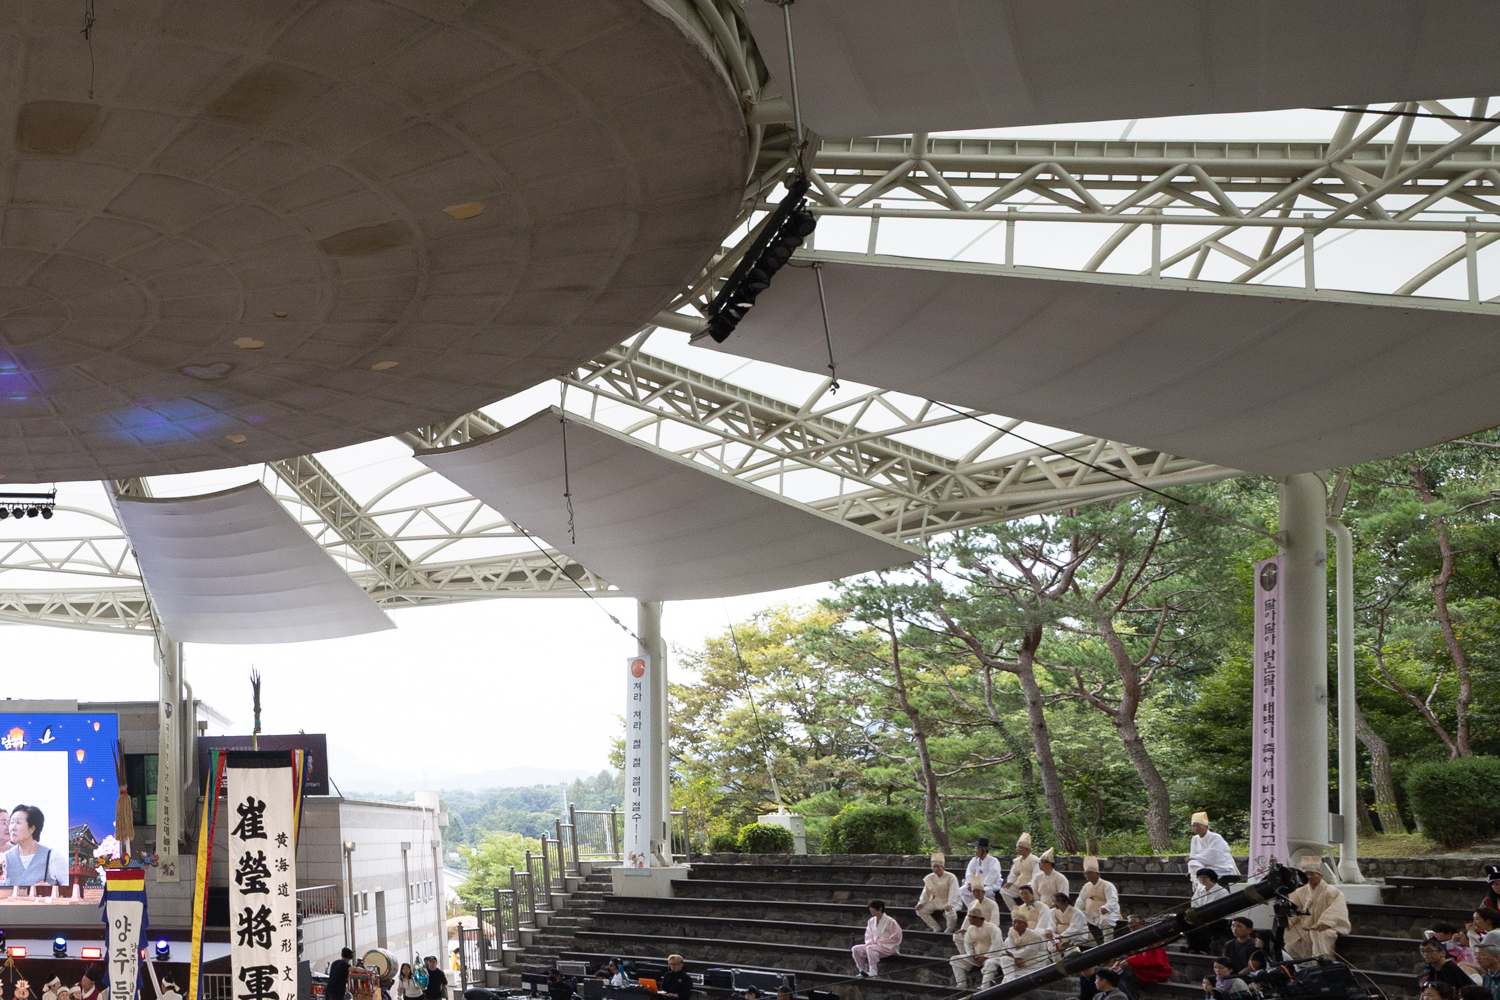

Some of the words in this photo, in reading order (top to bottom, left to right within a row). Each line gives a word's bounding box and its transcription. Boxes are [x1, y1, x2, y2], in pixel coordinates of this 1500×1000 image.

[1263, 598, 1277, 646] 달아달아
[1263, 649, 1276, 698] 밝은달아
[1262, 702, 1276, 739] 태백이
[1261, 743, 1276, 780] 죽어서
